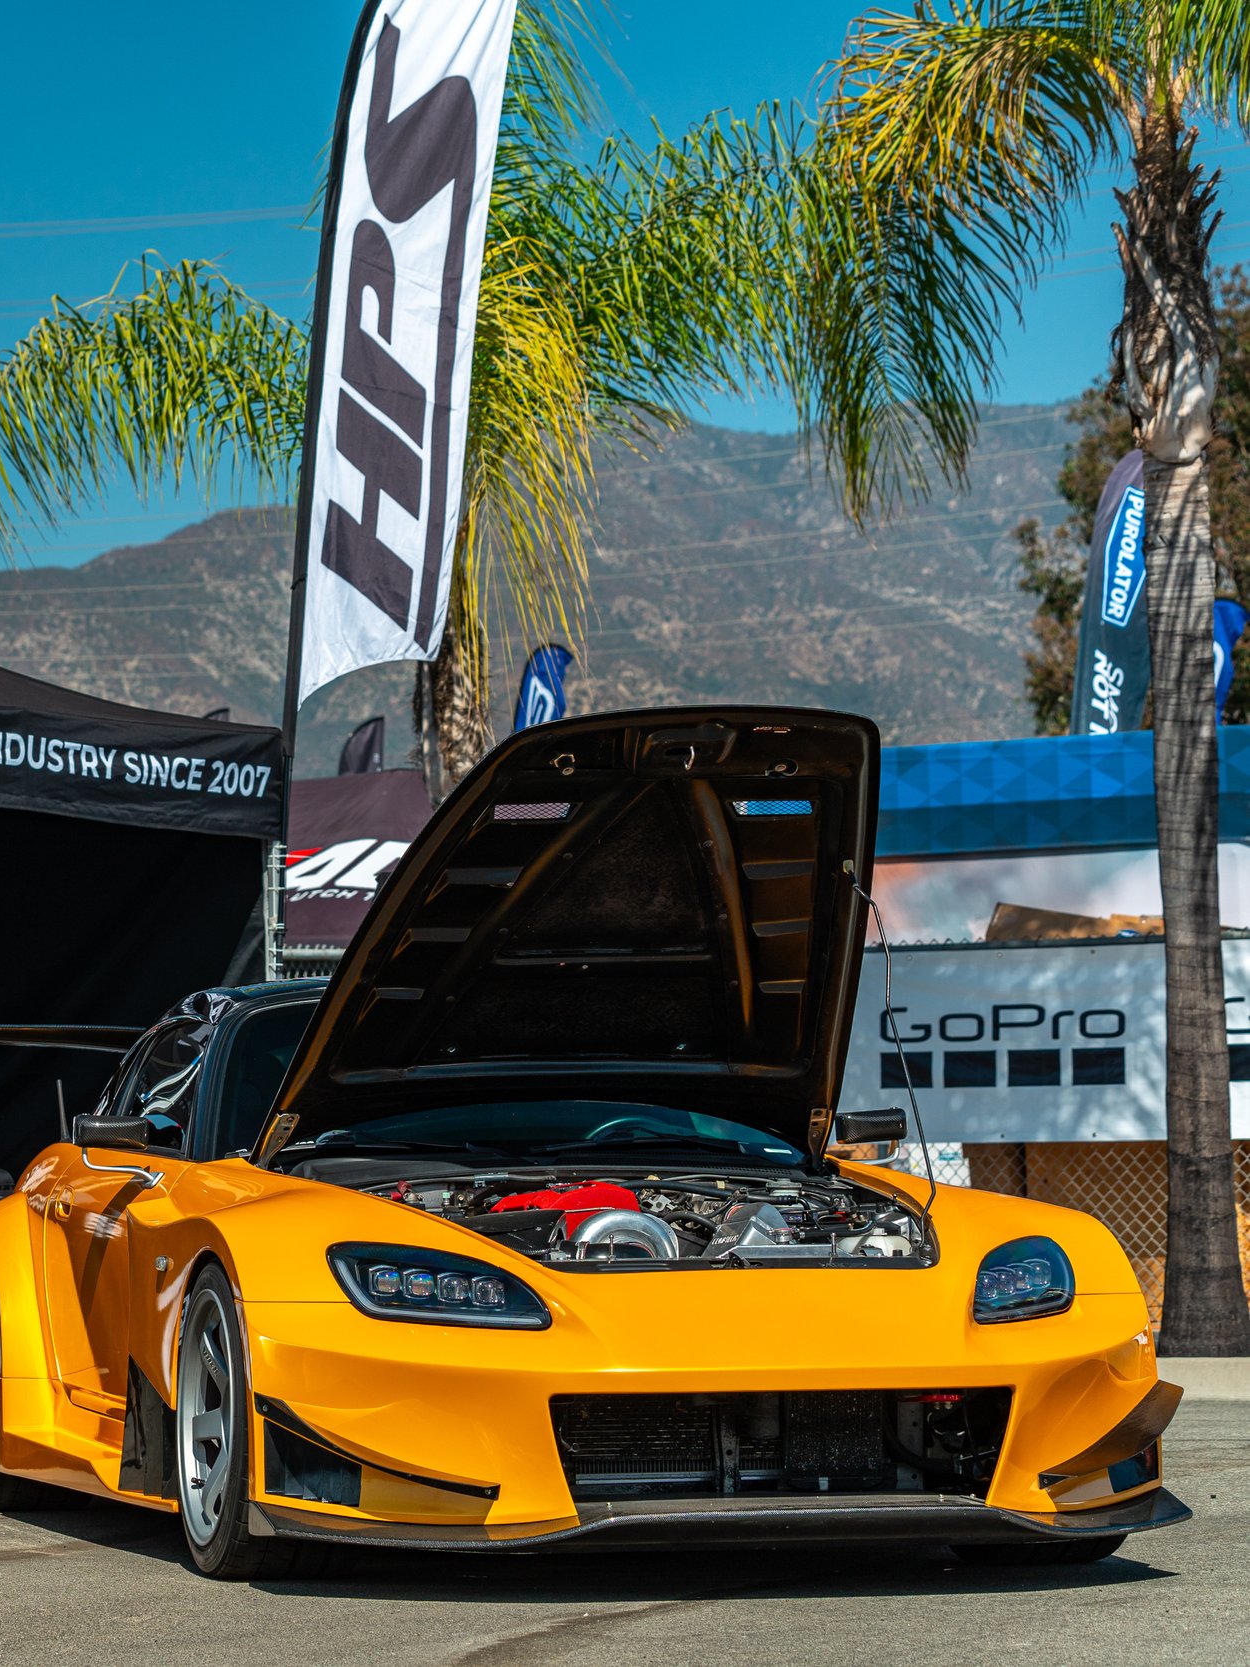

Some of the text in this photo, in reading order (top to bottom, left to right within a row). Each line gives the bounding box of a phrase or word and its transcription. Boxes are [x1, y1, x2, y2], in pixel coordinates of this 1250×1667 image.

[321, 15, 477, 653] HPS
[1107, 494, 1146, 621] PUROLATOR
[123, 751, 206, 791] SINCE
[207, 760, 272, 797] 2007
[880, 1003, 1126, 1043] GoPro
